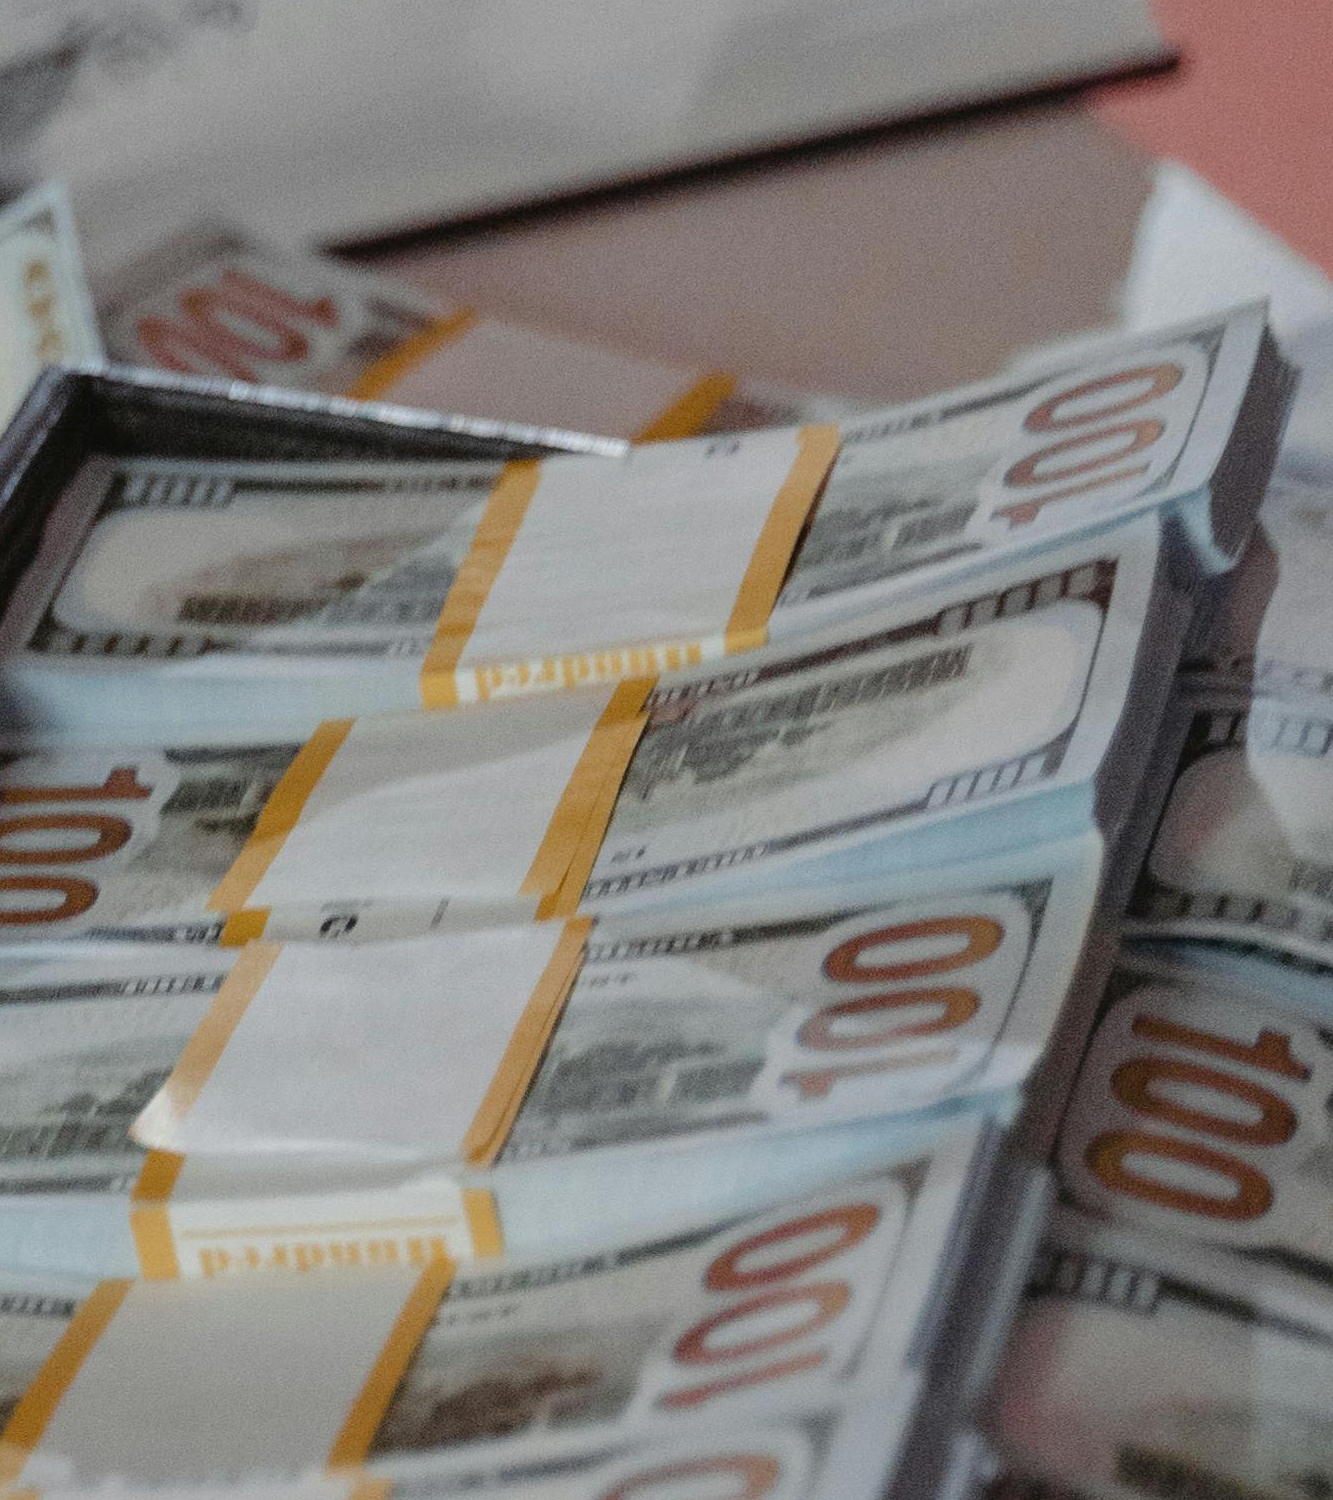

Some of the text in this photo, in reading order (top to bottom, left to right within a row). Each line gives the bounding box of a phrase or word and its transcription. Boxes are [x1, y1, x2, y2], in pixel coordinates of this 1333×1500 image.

[989, 362, 1184, 530] 100
[779, 914, 1005, 1098] 100
[1084, 1012, 1311, 1223] 100
[654, 1202, 881, 1410] 100
